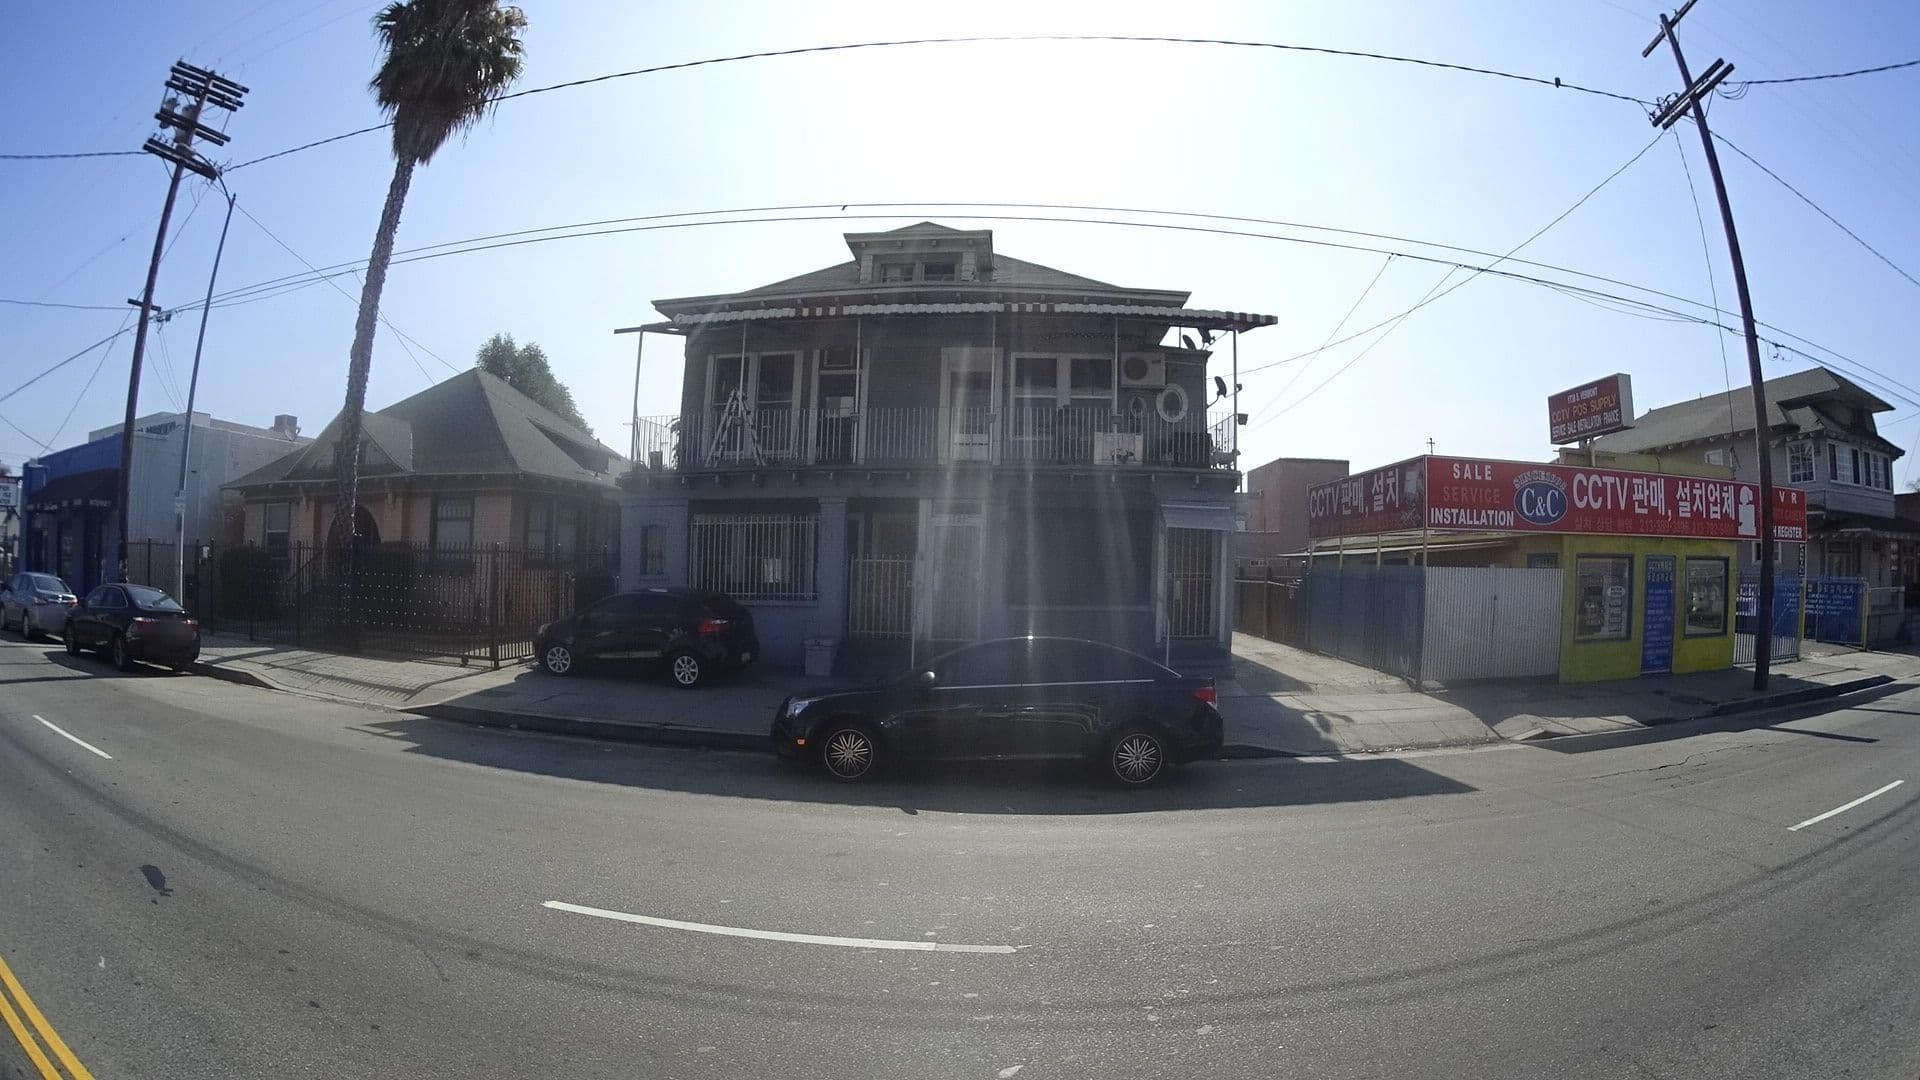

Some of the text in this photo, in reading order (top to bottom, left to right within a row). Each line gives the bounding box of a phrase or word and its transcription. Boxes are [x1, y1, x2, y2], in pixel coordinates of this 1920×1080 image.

[1580, 387, 1598, 400] VERMONT
[1552, 393, 1617, 423] CCTV POS SUPPLY
[1567, 420, 1577, 434] SALE
[1577, 414, 1602, 432] INSTALLATION
[1453, 462, 1493, 481] SALE
[1309, 483, 1340, 519] CCTV
[1371, 468, 1399, 512] 설치
[1442, 485, 1501, 504] SERVICE
[1522, 487, 1559, 518] C&C
[1572, 473, 1628, 511] CCTV
[1675, 480, 1736, 520] 설치업체
[1430, 507, 1515, 528] INSTALLATION
[1778, 525, 1803, 539] REGISTER
